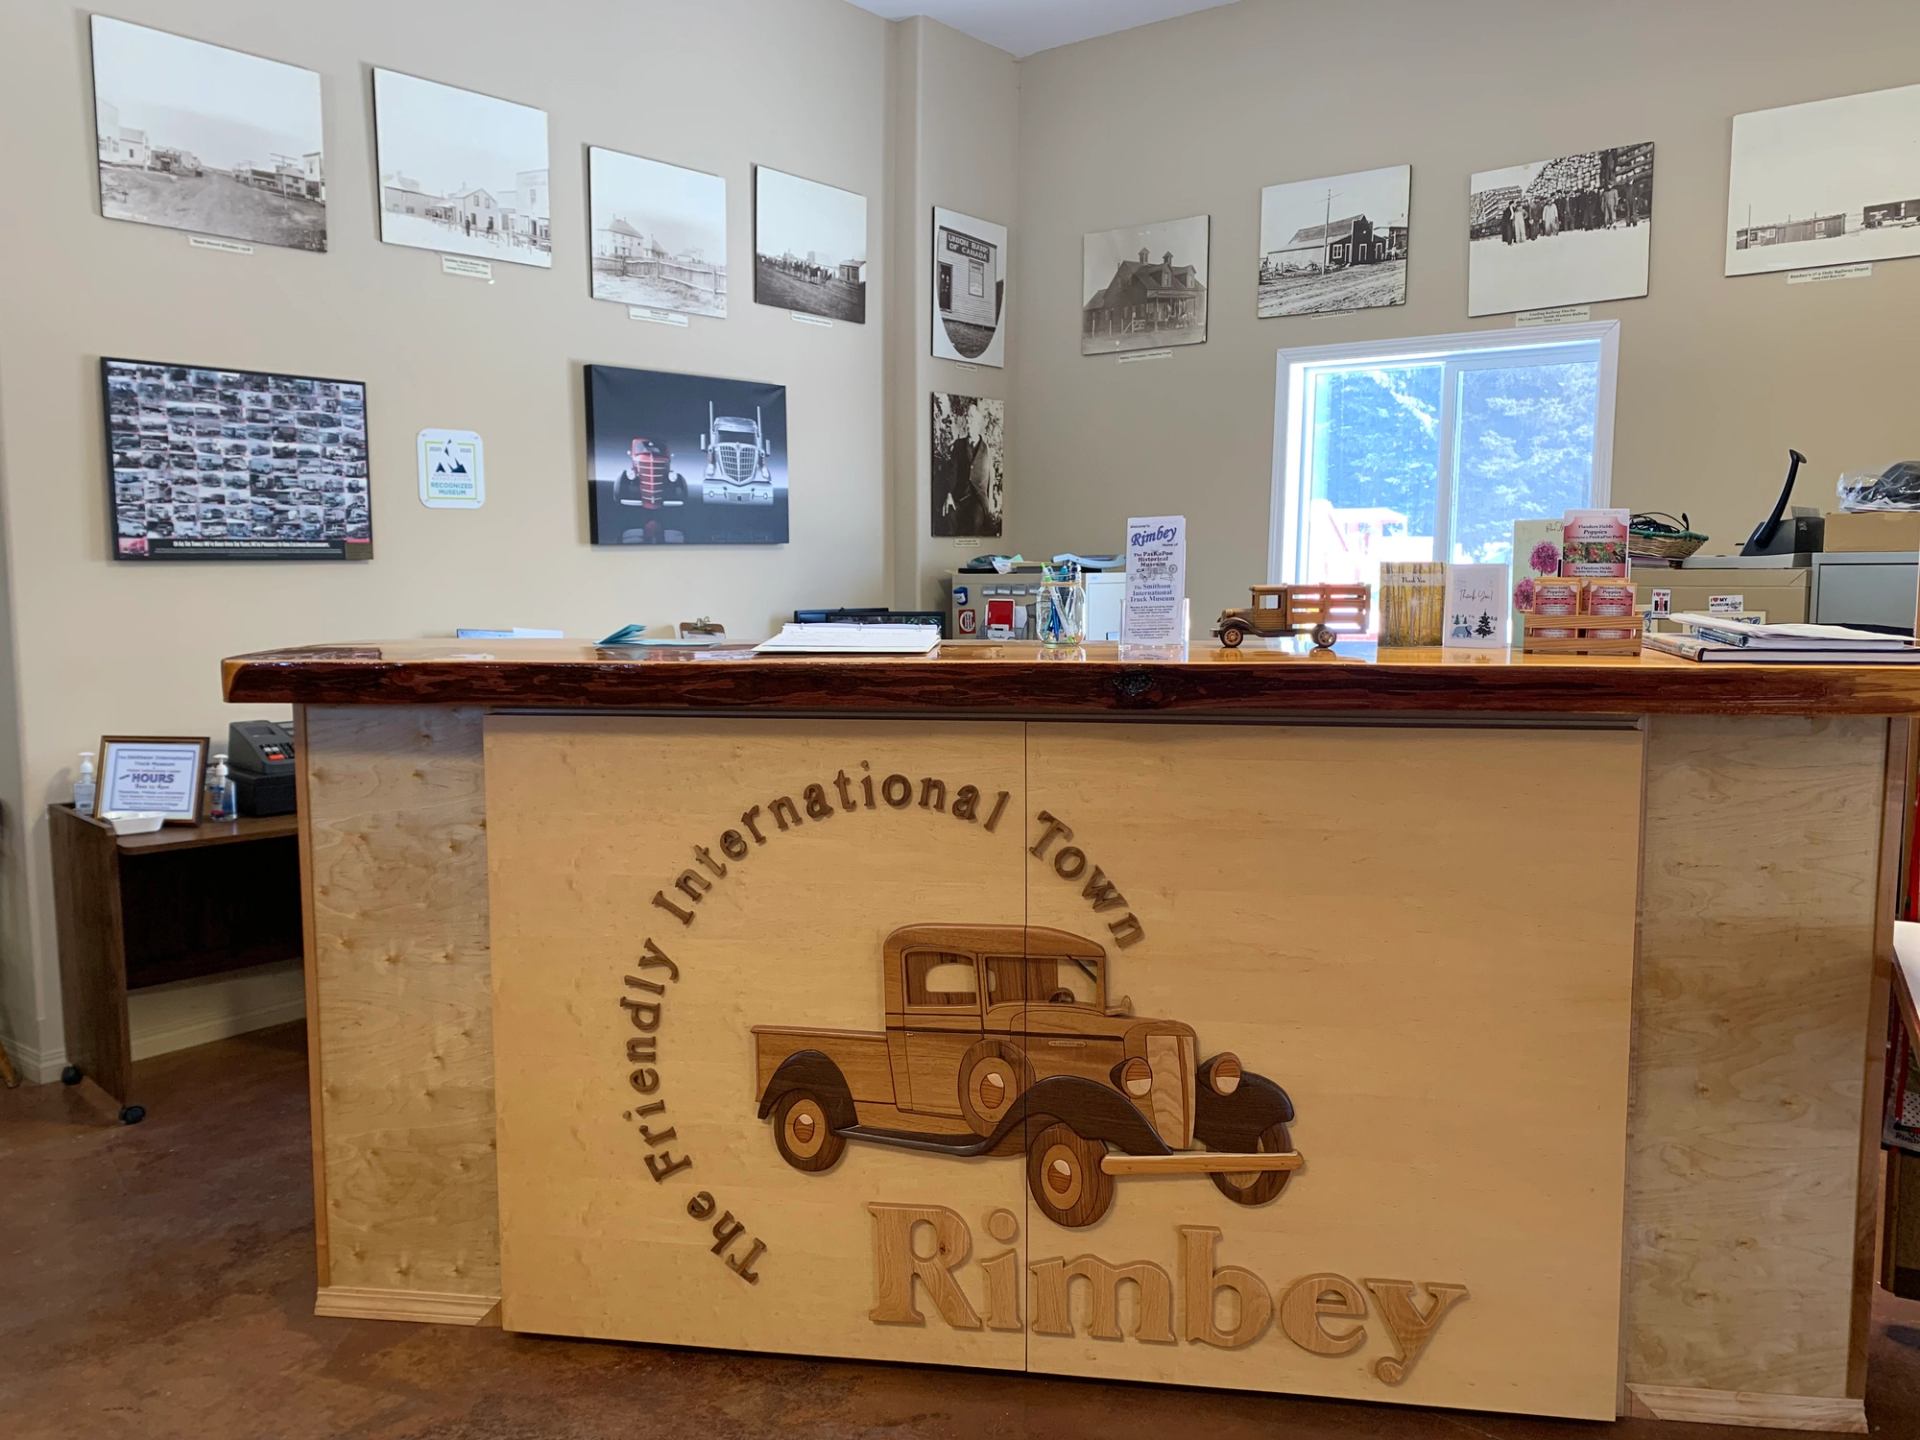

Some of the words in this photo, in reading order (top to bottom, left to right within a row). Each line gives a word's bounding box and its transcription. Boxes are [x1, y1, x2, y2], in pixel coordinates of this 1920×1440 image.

[961, 247, 987, 260] CANADA
[1131, 525, 1177, 546] Rimbey
[1459, 589, 1476, 601] Thank
[131, 774, 174, 783] HOURS
[652, 760, 1010, 926] International
[1029, 810, 1145, 950] Town
[620, 937, 692, 1184] Friendly
[687, 1190, 767, 1285] The
[866, 1201, 1469, 1386] Rimbey
